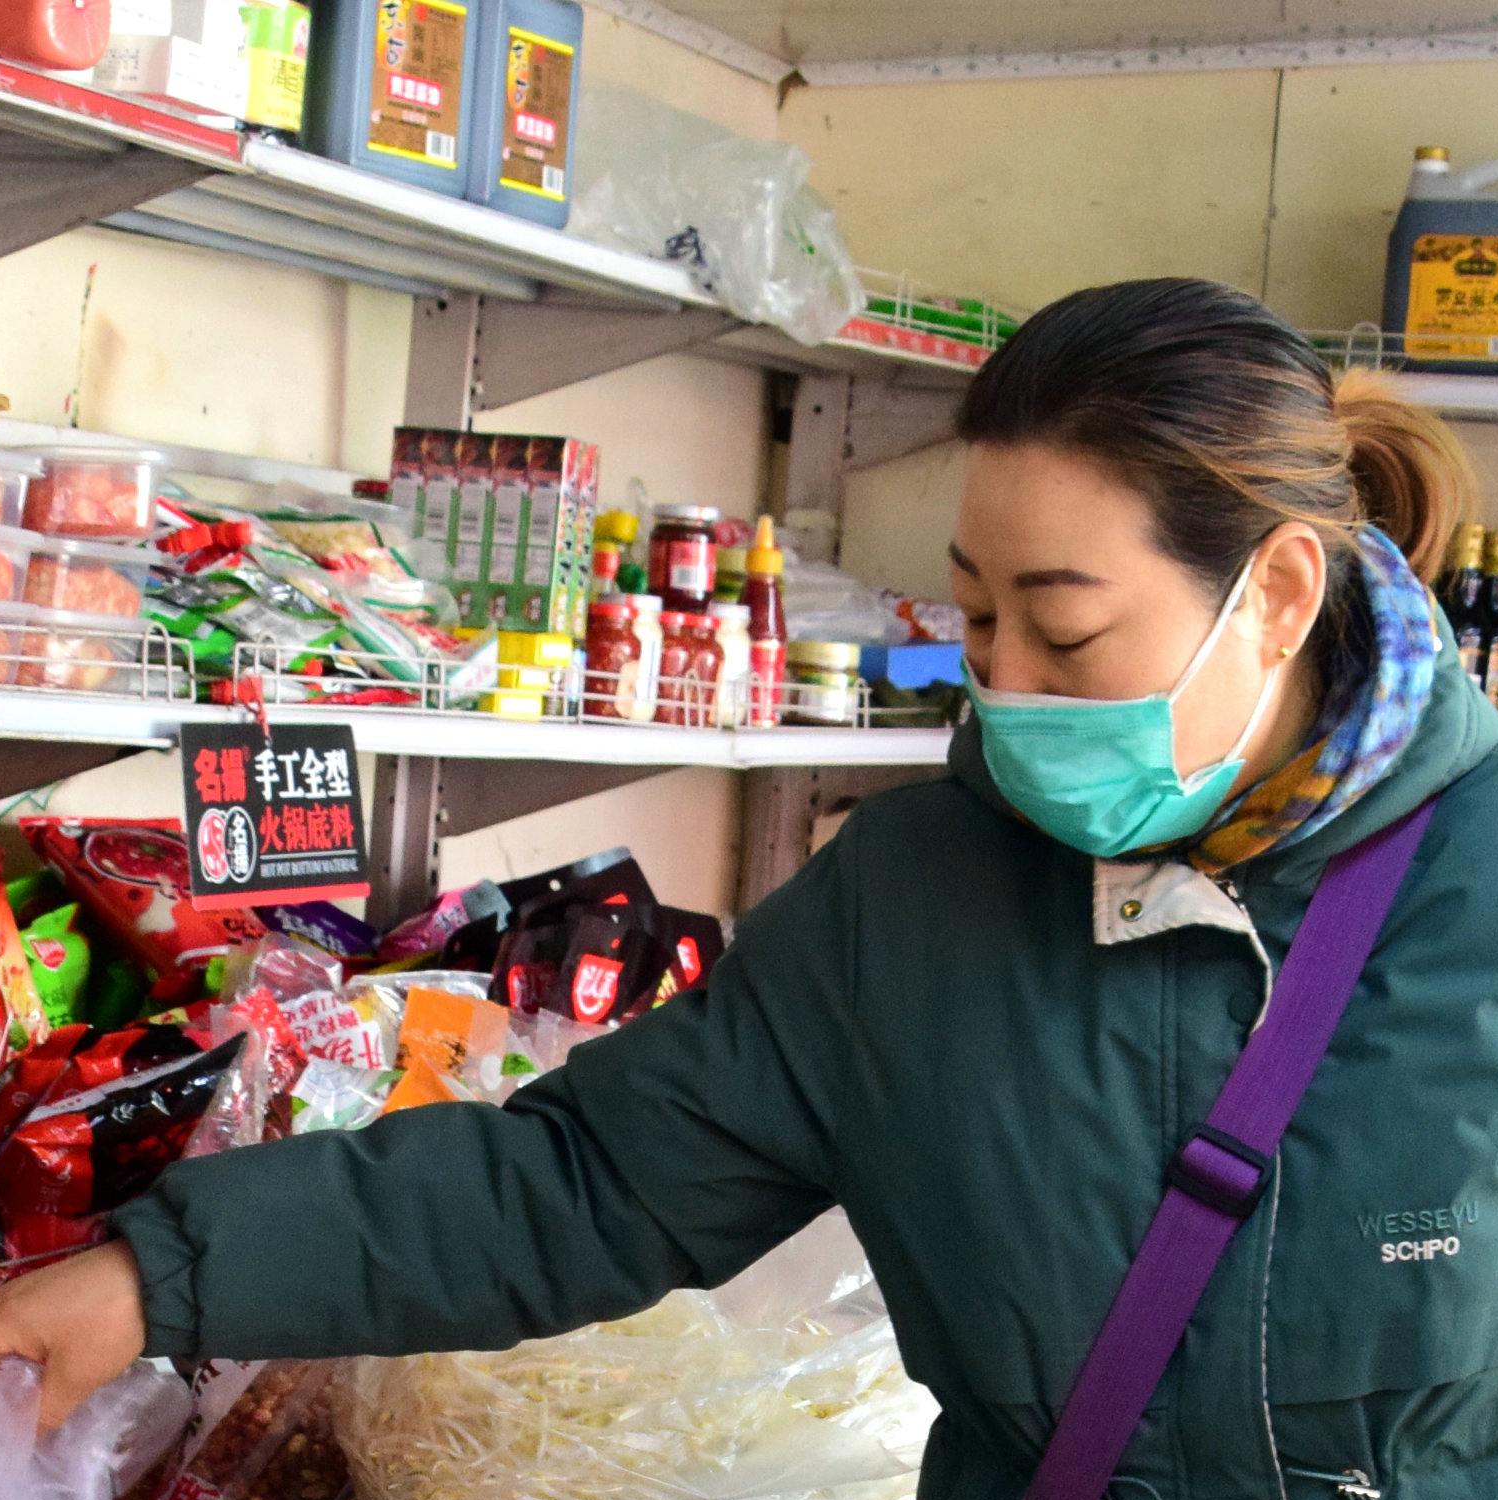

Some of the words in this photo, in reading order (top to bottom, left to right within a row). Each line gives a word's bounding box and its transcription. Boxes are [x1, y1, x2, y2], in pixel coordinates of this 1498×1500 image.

[259, 802, 355, 854] 火锅底料
[1380, 1236, 1461, 1264] SCHPO
